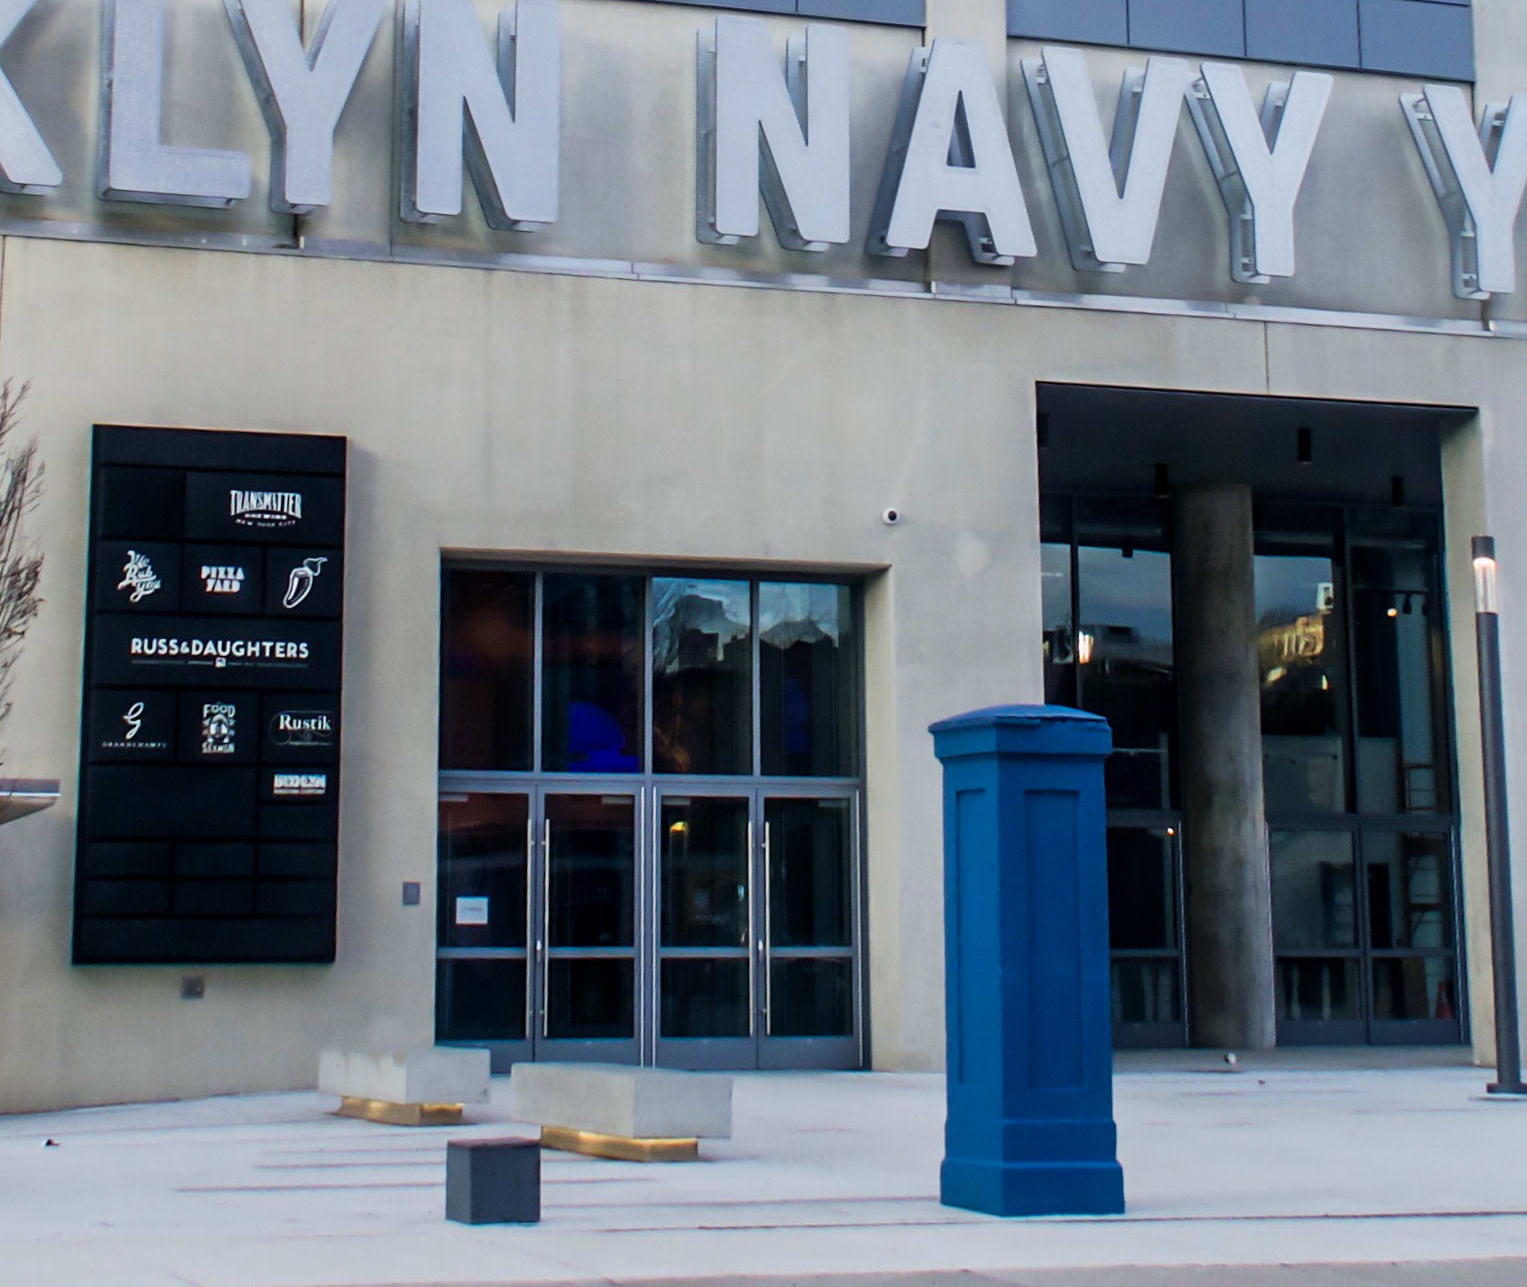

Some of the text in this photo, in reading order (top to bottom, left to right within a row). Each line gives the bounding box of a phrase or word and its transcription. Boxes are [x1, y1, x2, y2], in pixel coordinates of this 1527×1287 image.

[697, 15, 1334, 283] NAVY
[201, 565, 245, 580] PIZZA
[205, 579, 241, 593] YARD
[130, 637, 309, 658] RUSS&DAUGHTERS
[203, 703, 236, 718] FOOD
[279, 714, 331, 730] Rustik
